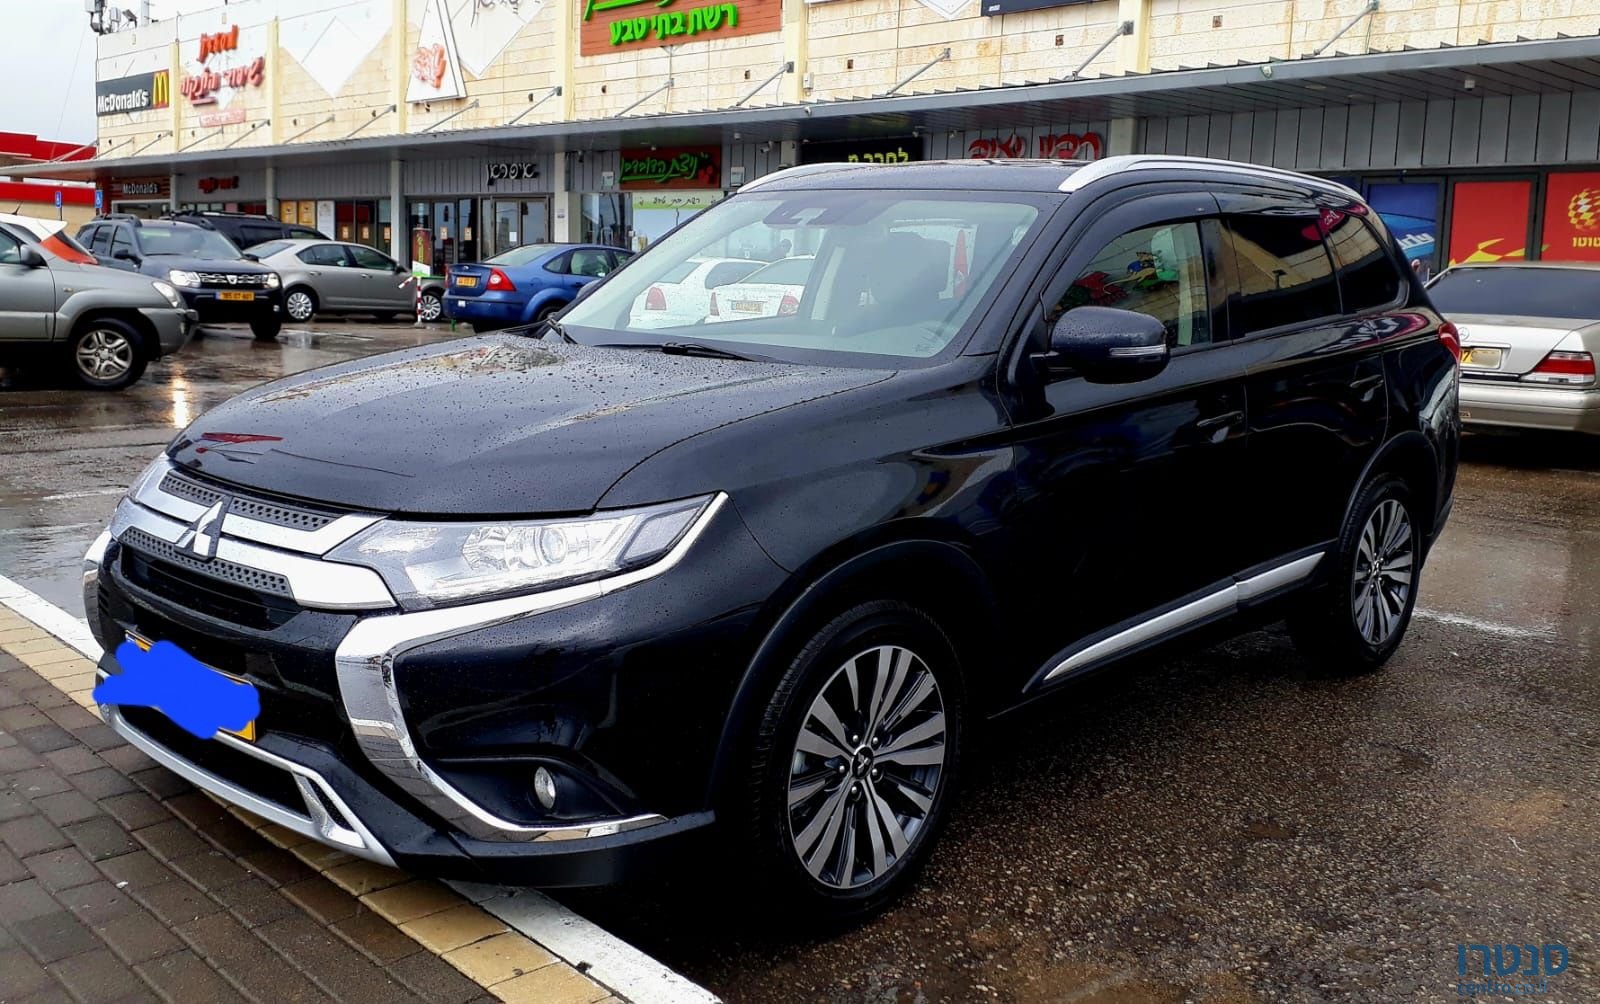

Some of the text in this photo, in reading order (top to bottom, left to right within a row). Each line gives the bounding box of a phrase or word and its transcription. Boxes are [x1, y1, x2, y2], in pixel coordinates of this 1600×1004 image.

[609, 3, 738, 45] רשת בתי טבע
[98, 89, 149, 112] McDonald's
[123, 183, 158, 194] McDonald's
[1572, 236, 1600, 247] טוטו
